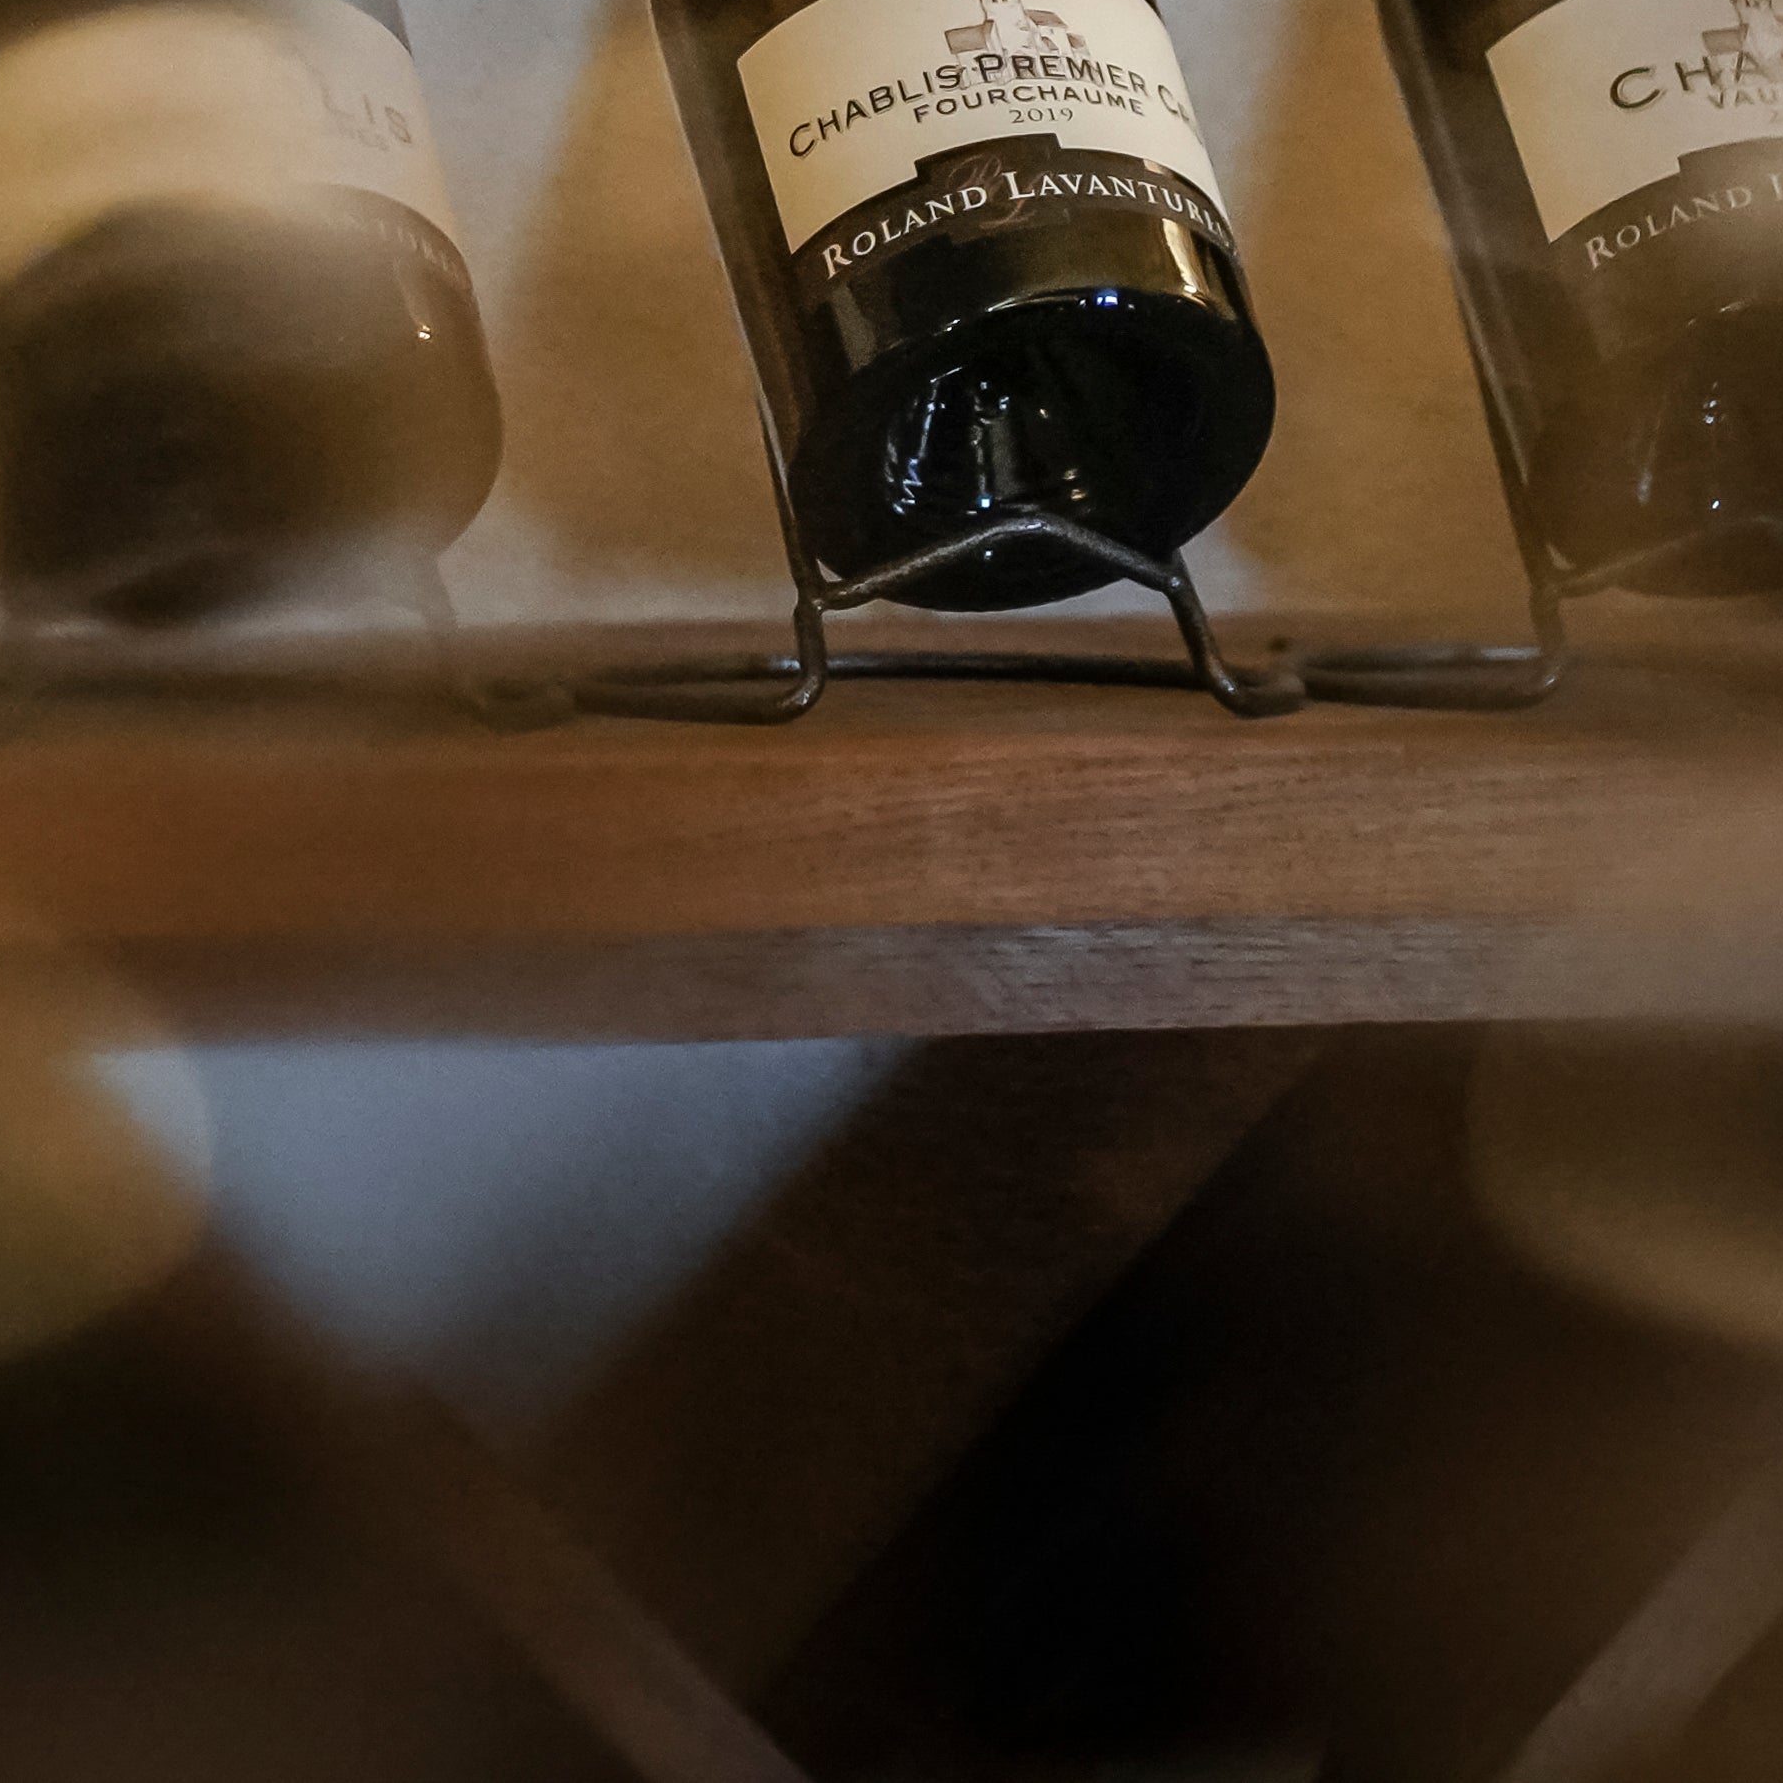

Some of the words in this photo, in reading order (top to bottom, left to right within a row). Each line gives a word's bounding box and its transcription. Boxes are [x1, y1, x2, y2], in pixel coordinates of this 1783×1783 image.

[788, 63, 962, 159] CHABLIS
[977, 53, 1148, 97] PREMIER
[912, 84, 1145, 124] FOURCHAUME
[1008, 107, 1075, 125] 2019
[821, 185, 988, 280] ROLAND
[1585, 183, 1753, 270] ROLAND
